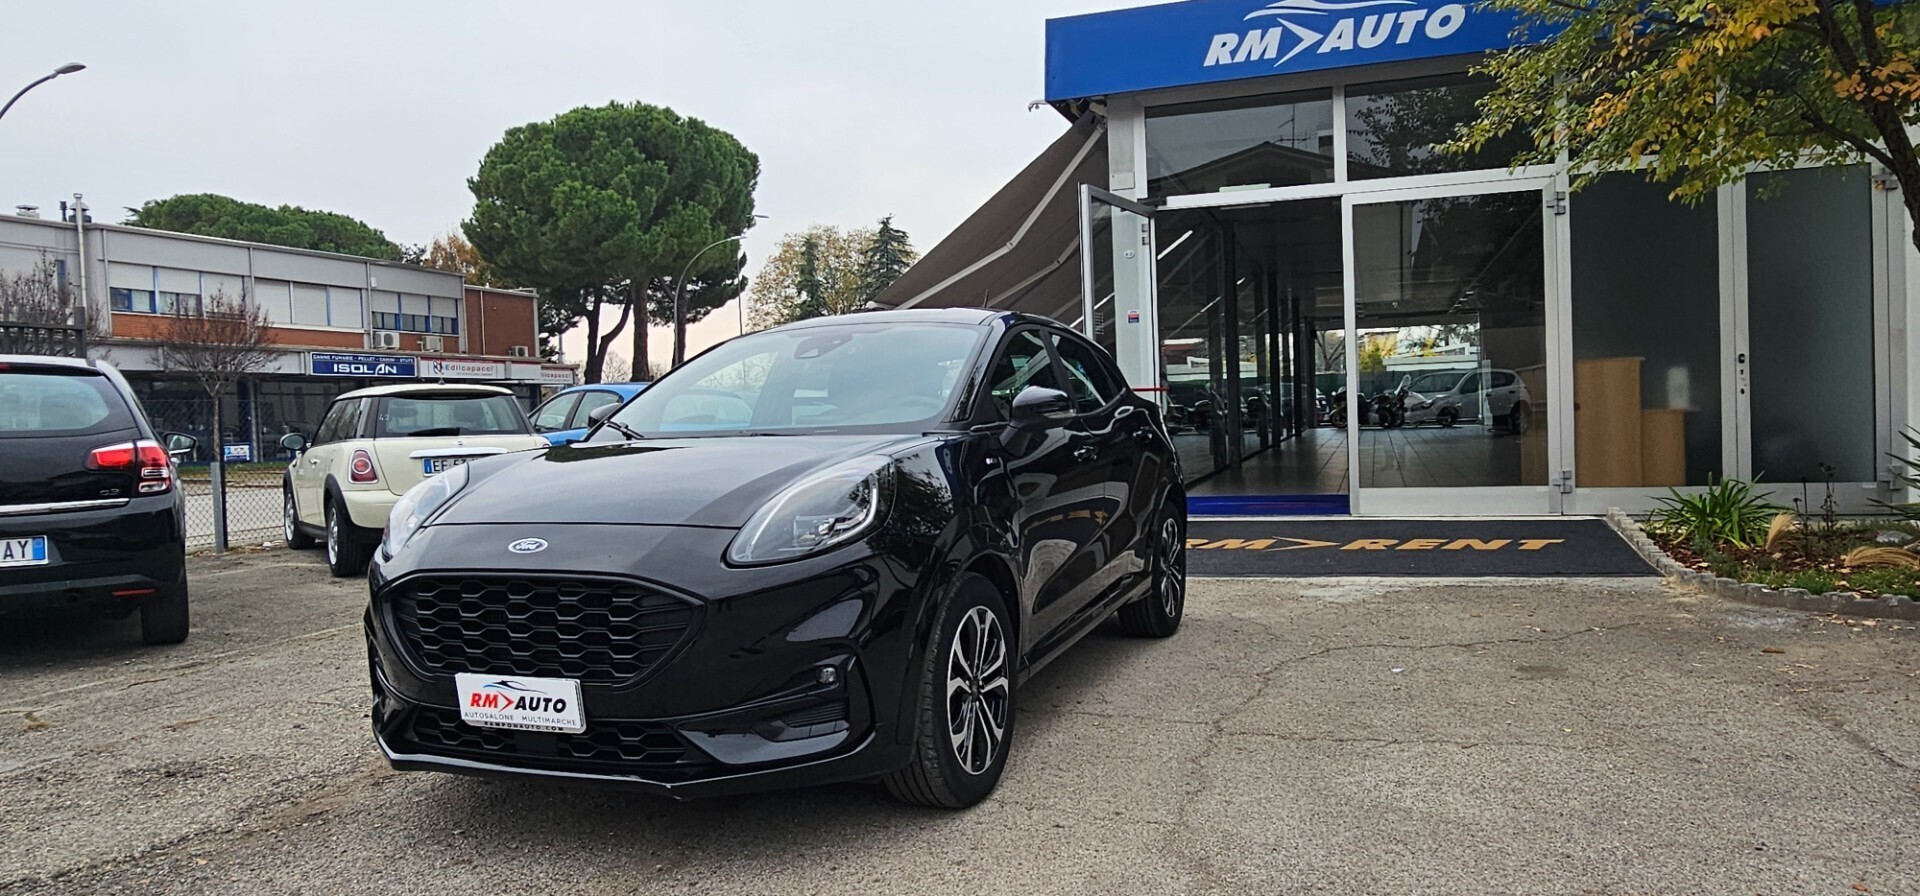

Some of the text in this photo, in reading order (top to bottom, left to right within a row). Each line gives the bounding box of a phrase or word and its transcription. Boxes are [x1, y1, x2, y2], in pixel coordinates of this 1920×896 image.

[1203, 4, 1466, 67] RM AUTO
[333, 363, 397, 376] ISOLAN
[445, 363, 494, 372] Edilcapacci
[3, 540, 29, 560] AY
[1339, 538, 1565, 550] RENT
[470, 693, 567, 714] RM AUTO
[464, 711, 576, 726] AUTOSALONE MULTIMARCHE
